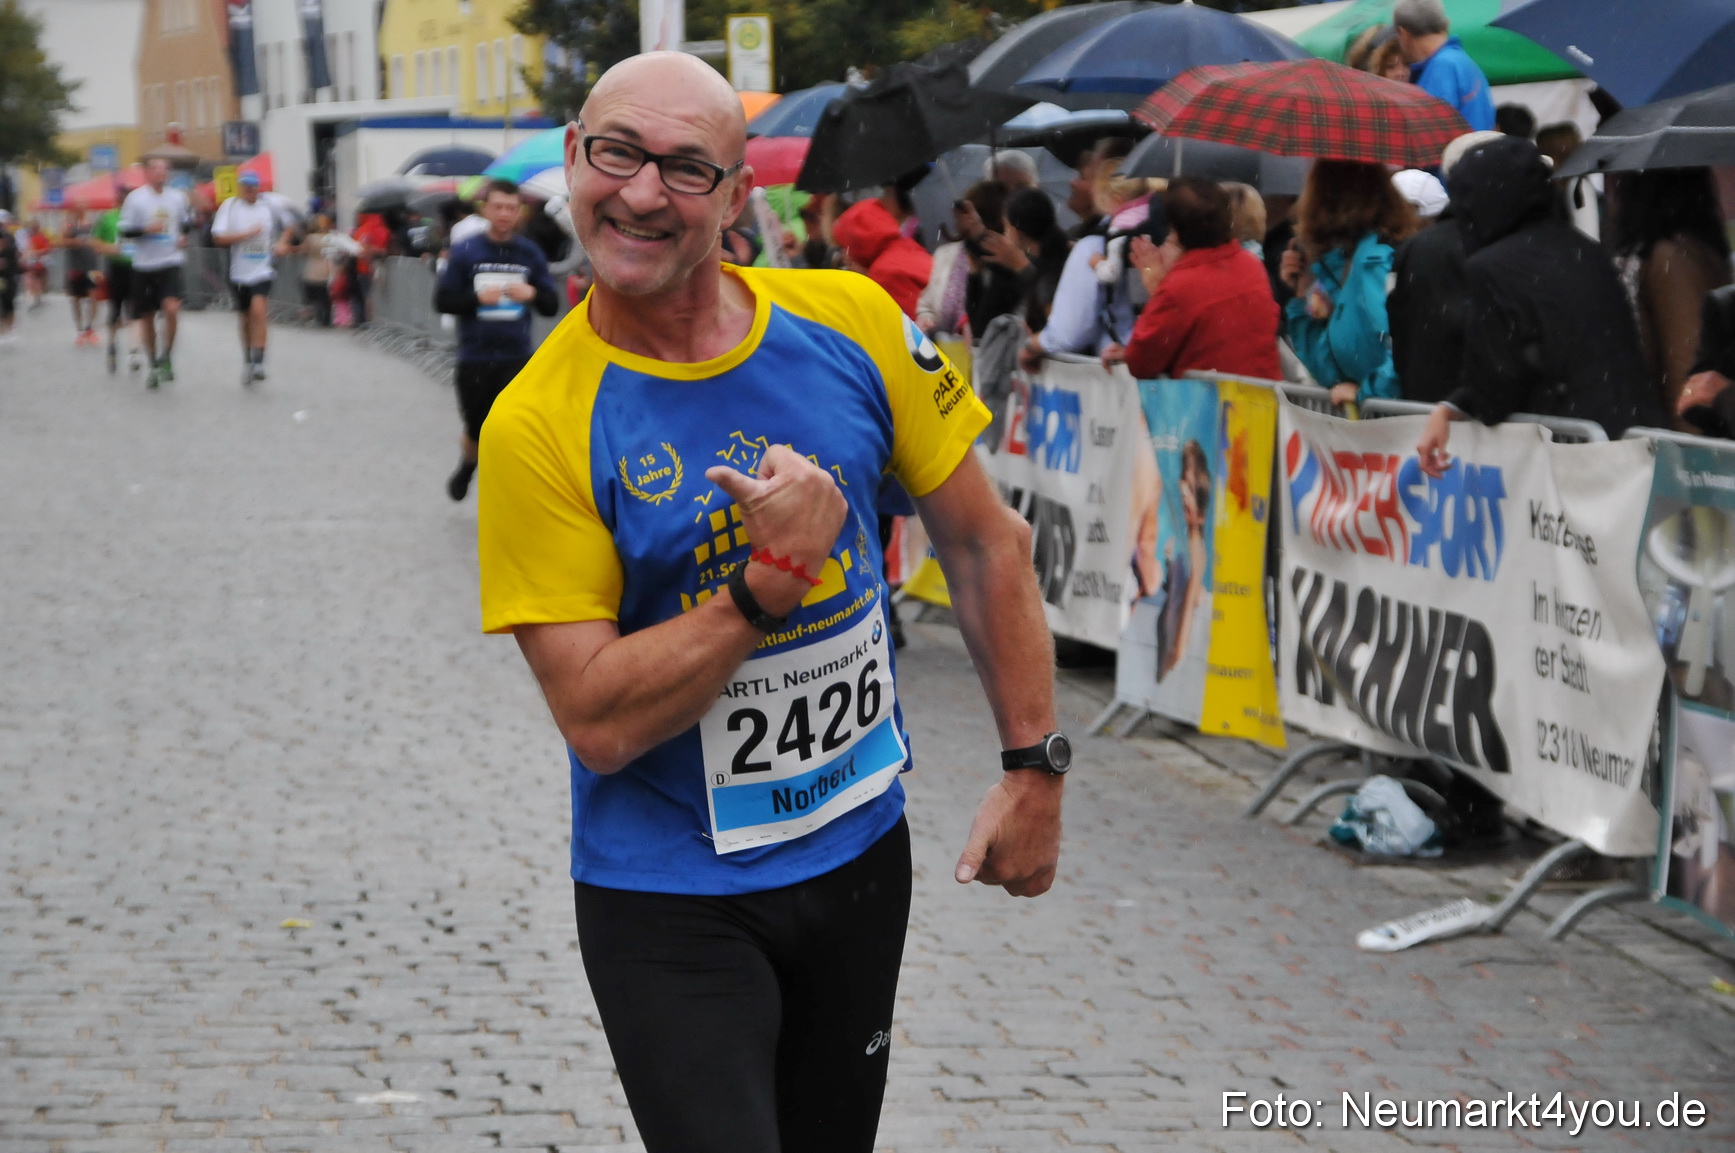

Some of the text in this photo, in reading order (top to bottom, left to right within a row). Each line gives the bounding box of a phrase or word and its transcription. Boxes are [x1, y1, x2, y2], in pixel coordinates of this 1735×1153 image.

[933, 369, 959, 408] PAR
[939, 383, 969, 420] Neum
[637, 466, 672, 486] Jahre
[639, 453, 656, 467] 15
[699, 560, 746, 585] 21.Se
[757, 587, 875, 649] tlauf-neumarkt.de
[719, 640, 868, 699] ARTL Neumarkt
[727, 659, 881, 775] 2426
[716, 774, 725, 785] D
[771, 754, 857, 815] Norbert
